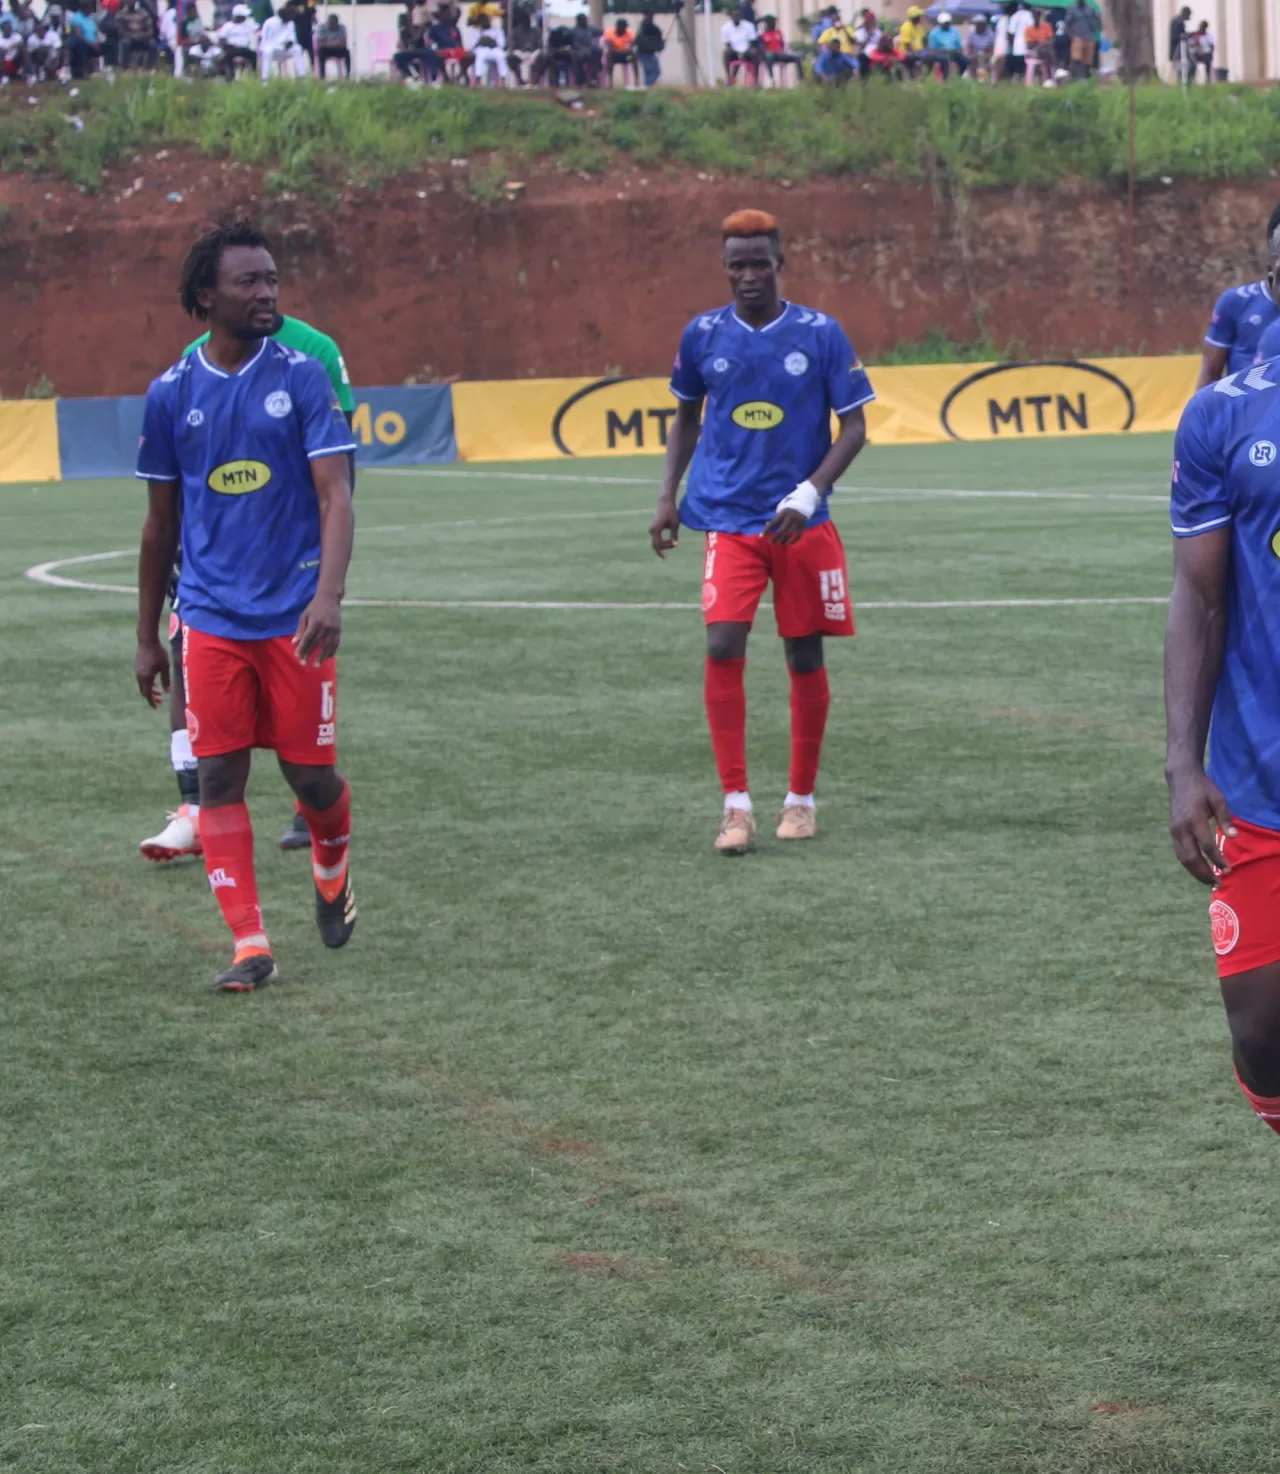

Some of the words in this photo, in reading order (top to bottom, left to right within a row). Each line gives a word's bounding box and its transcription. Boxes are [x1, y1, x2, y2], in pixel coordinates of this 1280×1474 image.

[744, 409, 772, 421] MTN
[987, 392, 1089, 434] MTN
[606, 408, 677, 448] MT
[222, 468, 257, 487] MTN
